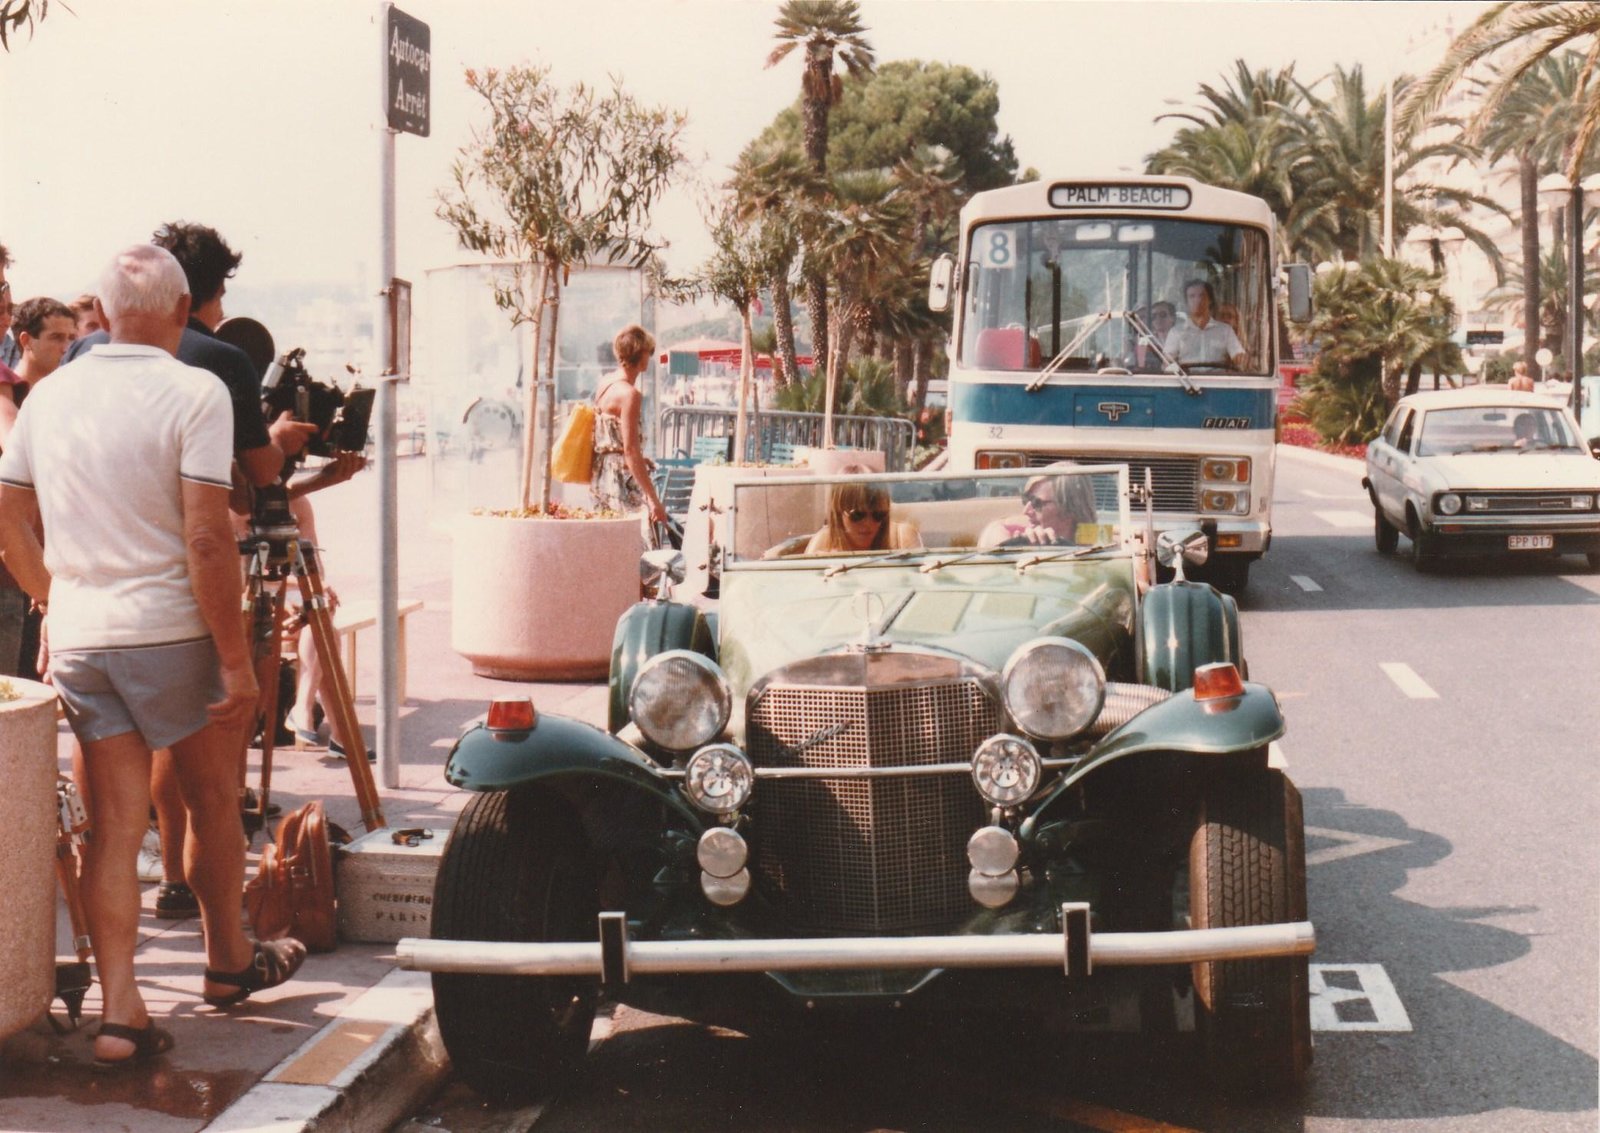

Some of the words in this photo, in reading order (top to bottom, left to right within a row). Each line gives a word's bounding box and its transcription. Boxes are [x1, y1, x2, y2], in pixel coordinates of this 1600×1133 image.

[989, 231, 1011, 265] 8
[1204, 417, 1249, 428] FIAT
[375, 911, 428, 921] PARIS
